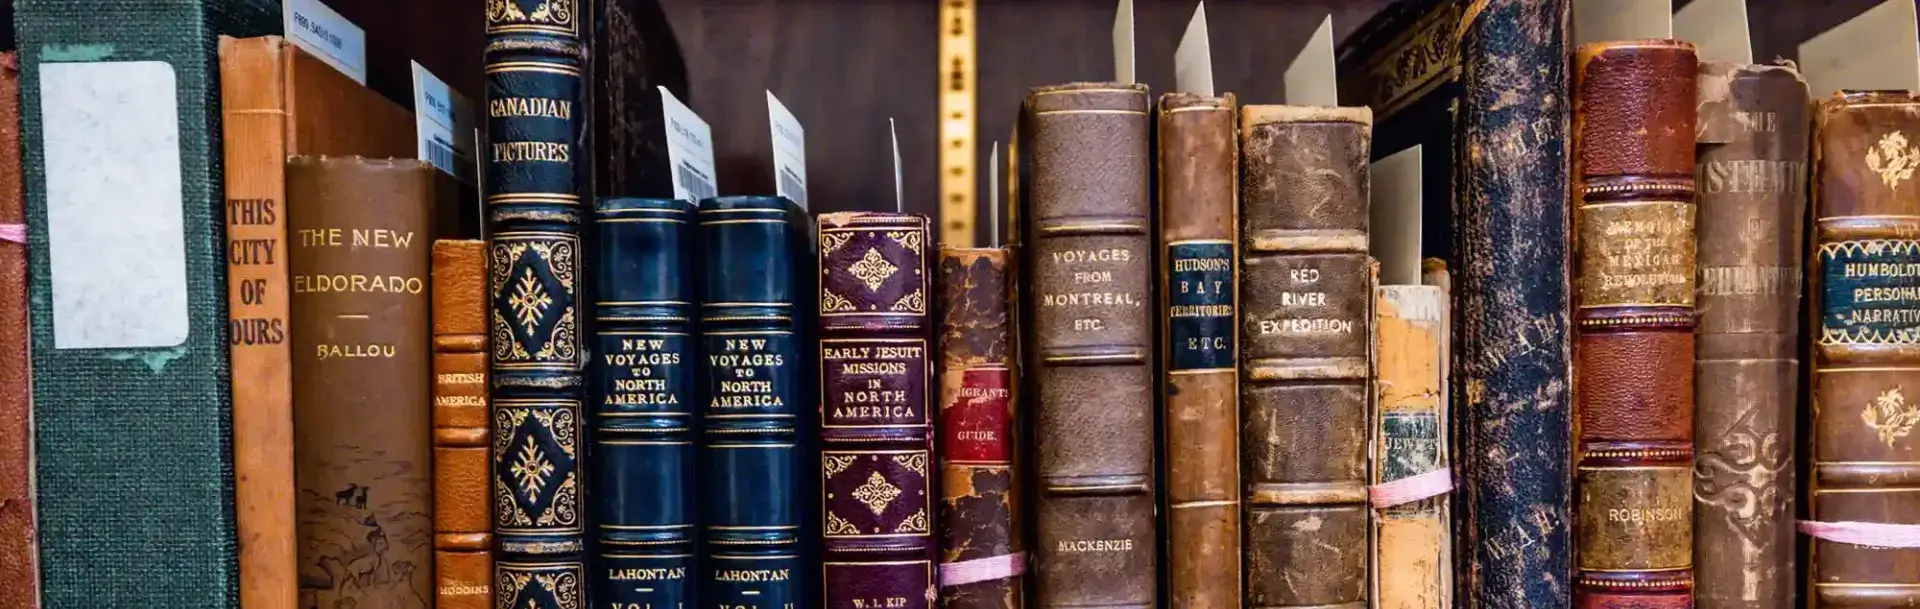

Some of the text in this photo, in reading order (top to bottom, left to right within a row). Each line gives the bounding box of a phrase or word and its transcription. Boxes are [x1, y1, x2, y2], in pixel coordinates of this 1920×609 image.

[490, 97, 572, 120] CANADIAN
[492, 141, 569, 162] PICTURES
[228, 198, 276, 225] THIS
[298, 229, 414, 249] THE NEW
[229, 239, 277, 266] CITY
[1052, 249, 1130, 264] VOYAGES
[1175, 258, 1230, 272] HUDSON'S
[1074, 270, 1112, 285] FROM
[1290, 268, 1320, 283] RED
[294, 274, 423, 294] ELDORADO
[1181, 280, 1222, 294] BAY
[240, 278, 267, 305] OF
[1854, 287, 1920, 302] PERSONA
[1043, 292, 1140, 307] MONTREAL,
[1281, 291, 1326, 307] RIVER
[1852, 309, 1920, 322] NARRATIV
[1074, 319, 1104, 331] ETC.
[1260, 318, 1352, 334] EXPEDITION
[230, 318, 284, 346] OURS
[622, 339, 665, 350] NEW
[725, 339, 766, 350] NEW
[1188, 336, 1226, 350] ETC.
[317, 344, 396, 360] BALLOU
[824, 346, 922, 359] EARLY JESUIT
[605, 353, 680, 366] VOYAGES
[709, 354, 784, 367] VOYAGES
[631, 367, 651, 377] TO
[735, 368, 754, 378] TO
[843, 362, 907, 374] MISSIONS
[438, 373, 485, 384] BRITISH
[615, 379, 665, 391] NORTH
[868, 379, 881, 389] IN
[721, 381, 772, 393] NORTH
[435, 395, 486, 407] AMERICA
[604, 392, 678, 405] AMERICA
[710, 395, 784, 408] AMERICA
[844, 390, 906, 403] NORTH
[833, 406, 915, 418] AMERICA
[957, 431, 998, 441] GUIDE.
[1608, 507, 1682, 522] ROBINSON
[1056, 539, 1133, 552] MACKENZIE
[609, 567, 686, 580] LAHONTAN
[715, 569, 789, 582] LAHONTAN
[852, 599, 869, 609] W.
[886, 597, 907, 607] KIP
